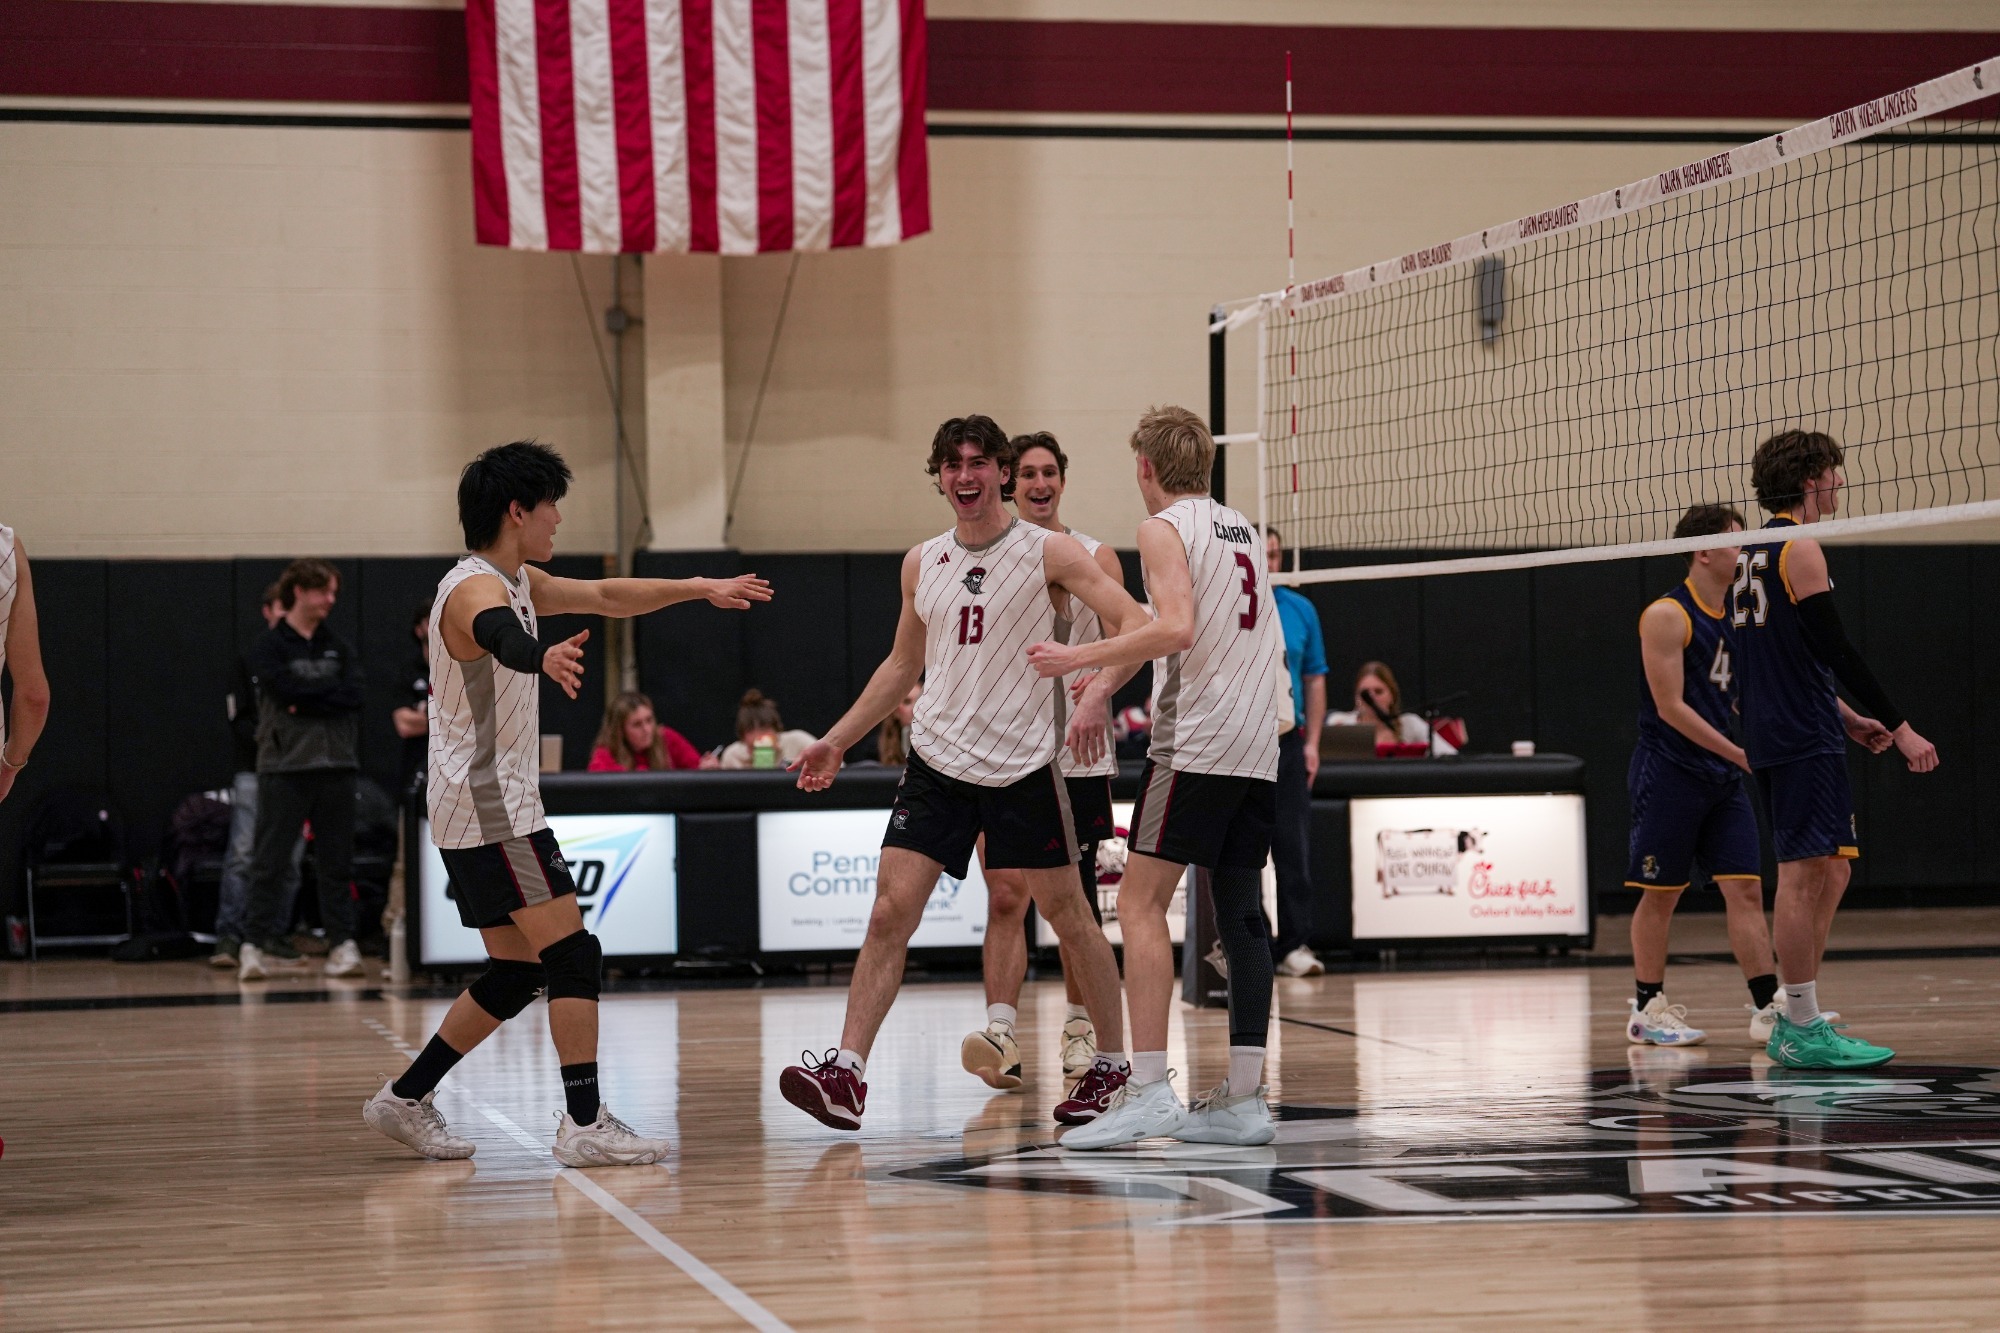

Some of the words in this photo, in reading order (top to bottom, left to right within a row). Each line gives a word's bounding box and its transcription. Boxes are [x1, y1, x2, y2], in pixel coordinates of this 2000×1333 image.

[1829, 109, 1857, 139] CAIRN
[1857, 87, 1918, 129] HIGHLANDERS
[1660, 168, 1682, 195] CAIRN
[1682, 151, 1733, 188] HIGHLANDERS
[1518, 217, 1538, 238] CAIRN
[1538, 202, 1579, 233] HIGHLANDERS
[1213, 521, 1252, 544] CAIRN
[1234, 551, 1258, 631] 3
[1732, 550, 1769, 627] 25
[958, 605, 984, 645] 13
[1710, 637, 1732, 692] 4
